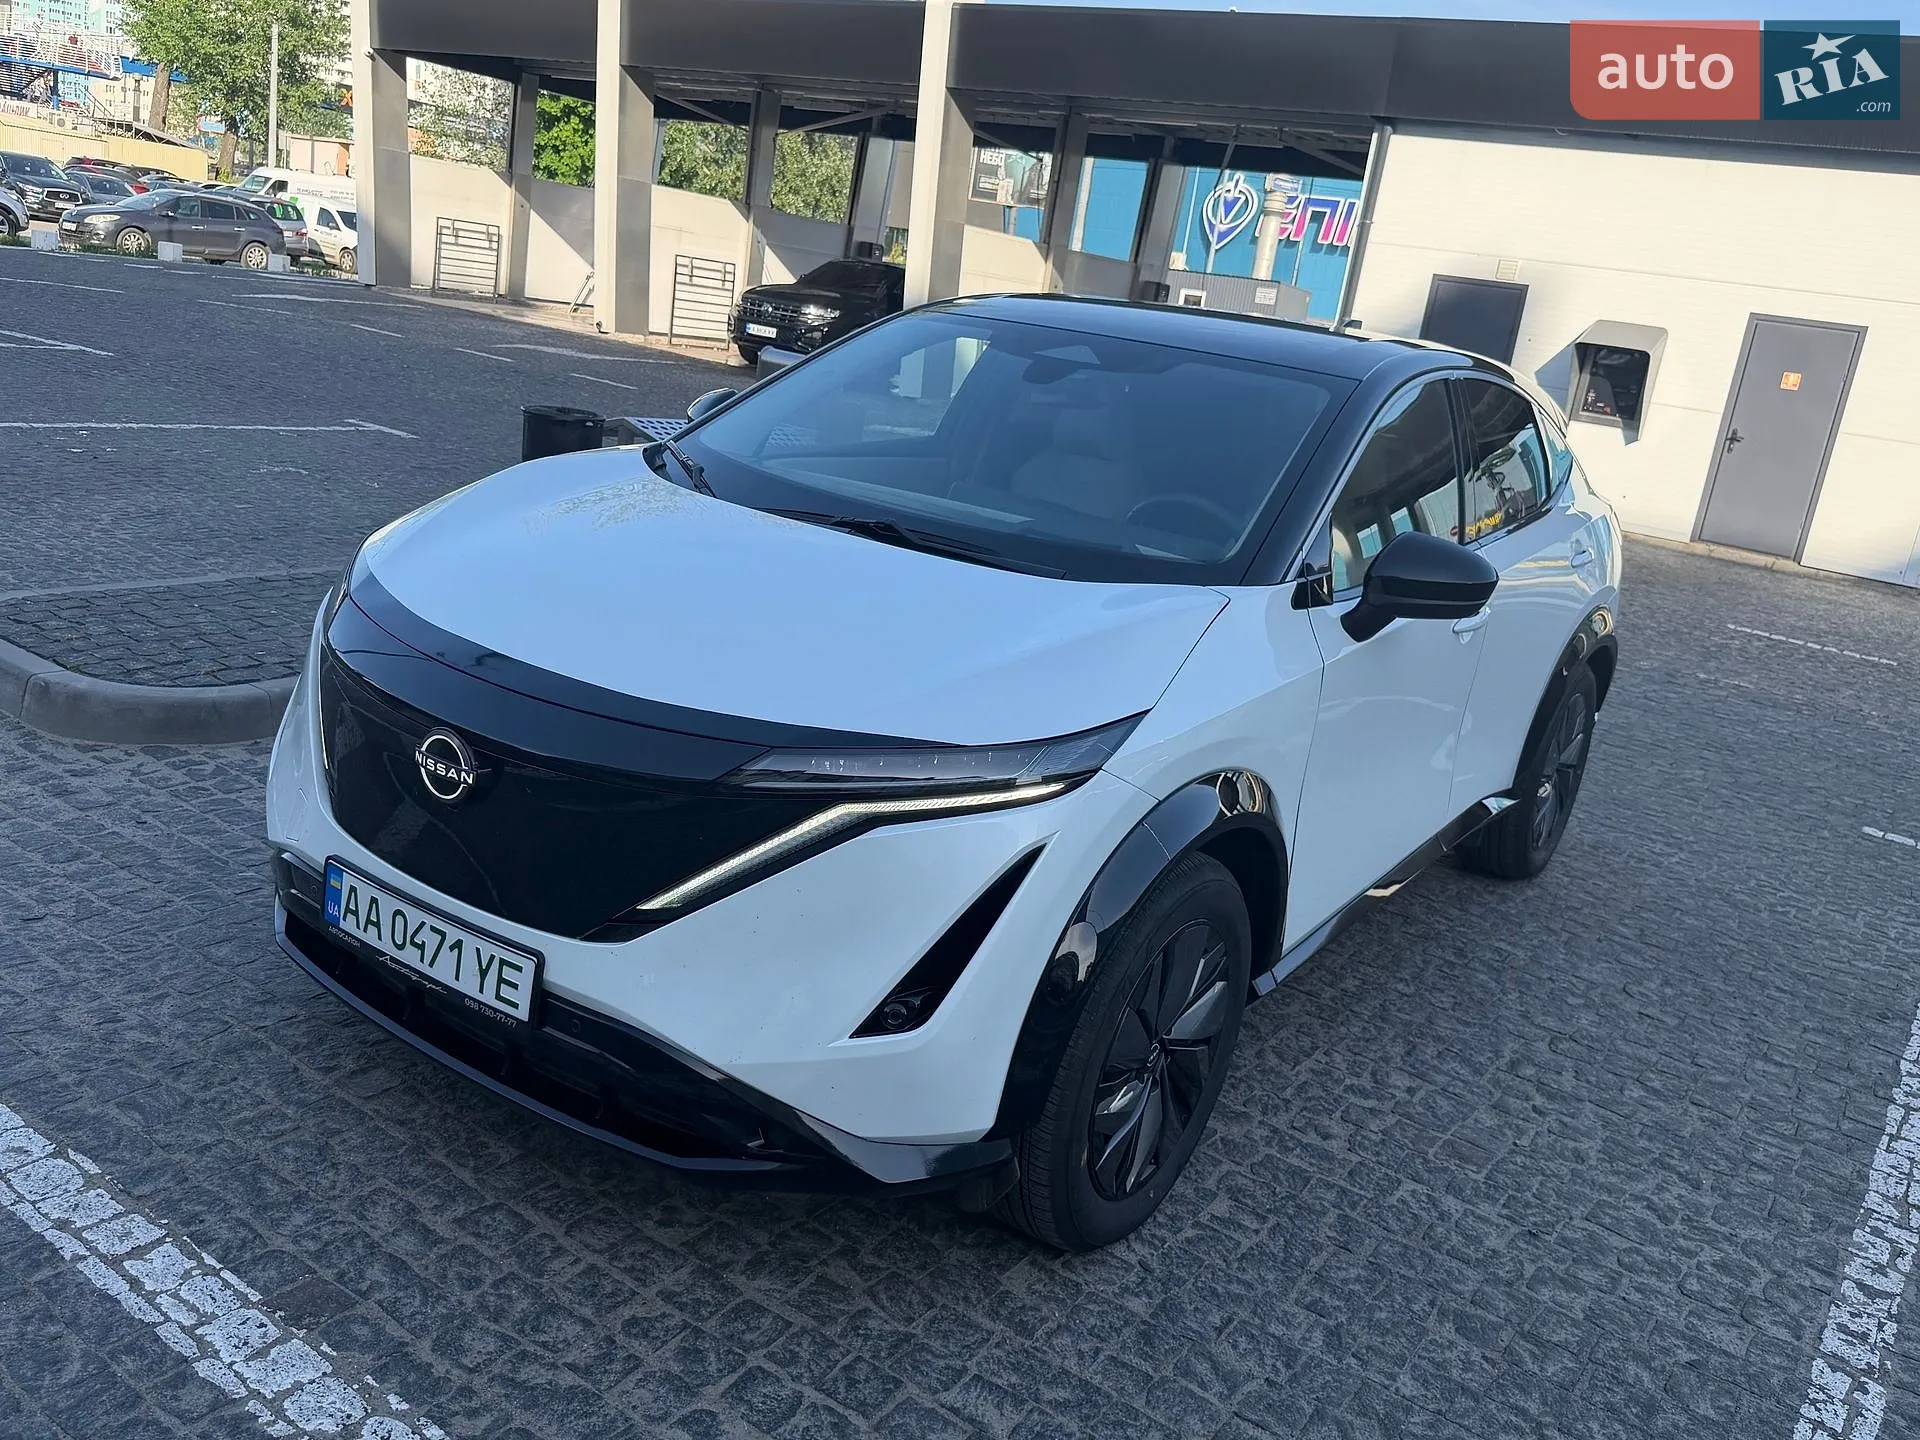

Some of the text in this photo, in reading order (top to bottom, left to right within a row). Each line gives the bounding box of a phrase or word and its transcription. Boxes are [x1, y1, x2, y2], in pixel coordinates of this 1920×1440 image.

[980, 149, 1006, 167] НЕБО
[415, 750, 474, 784] NISSAN
[328, 900, 339, 917] UA
[342, 884, 524, 1010] AA 0471 YE
